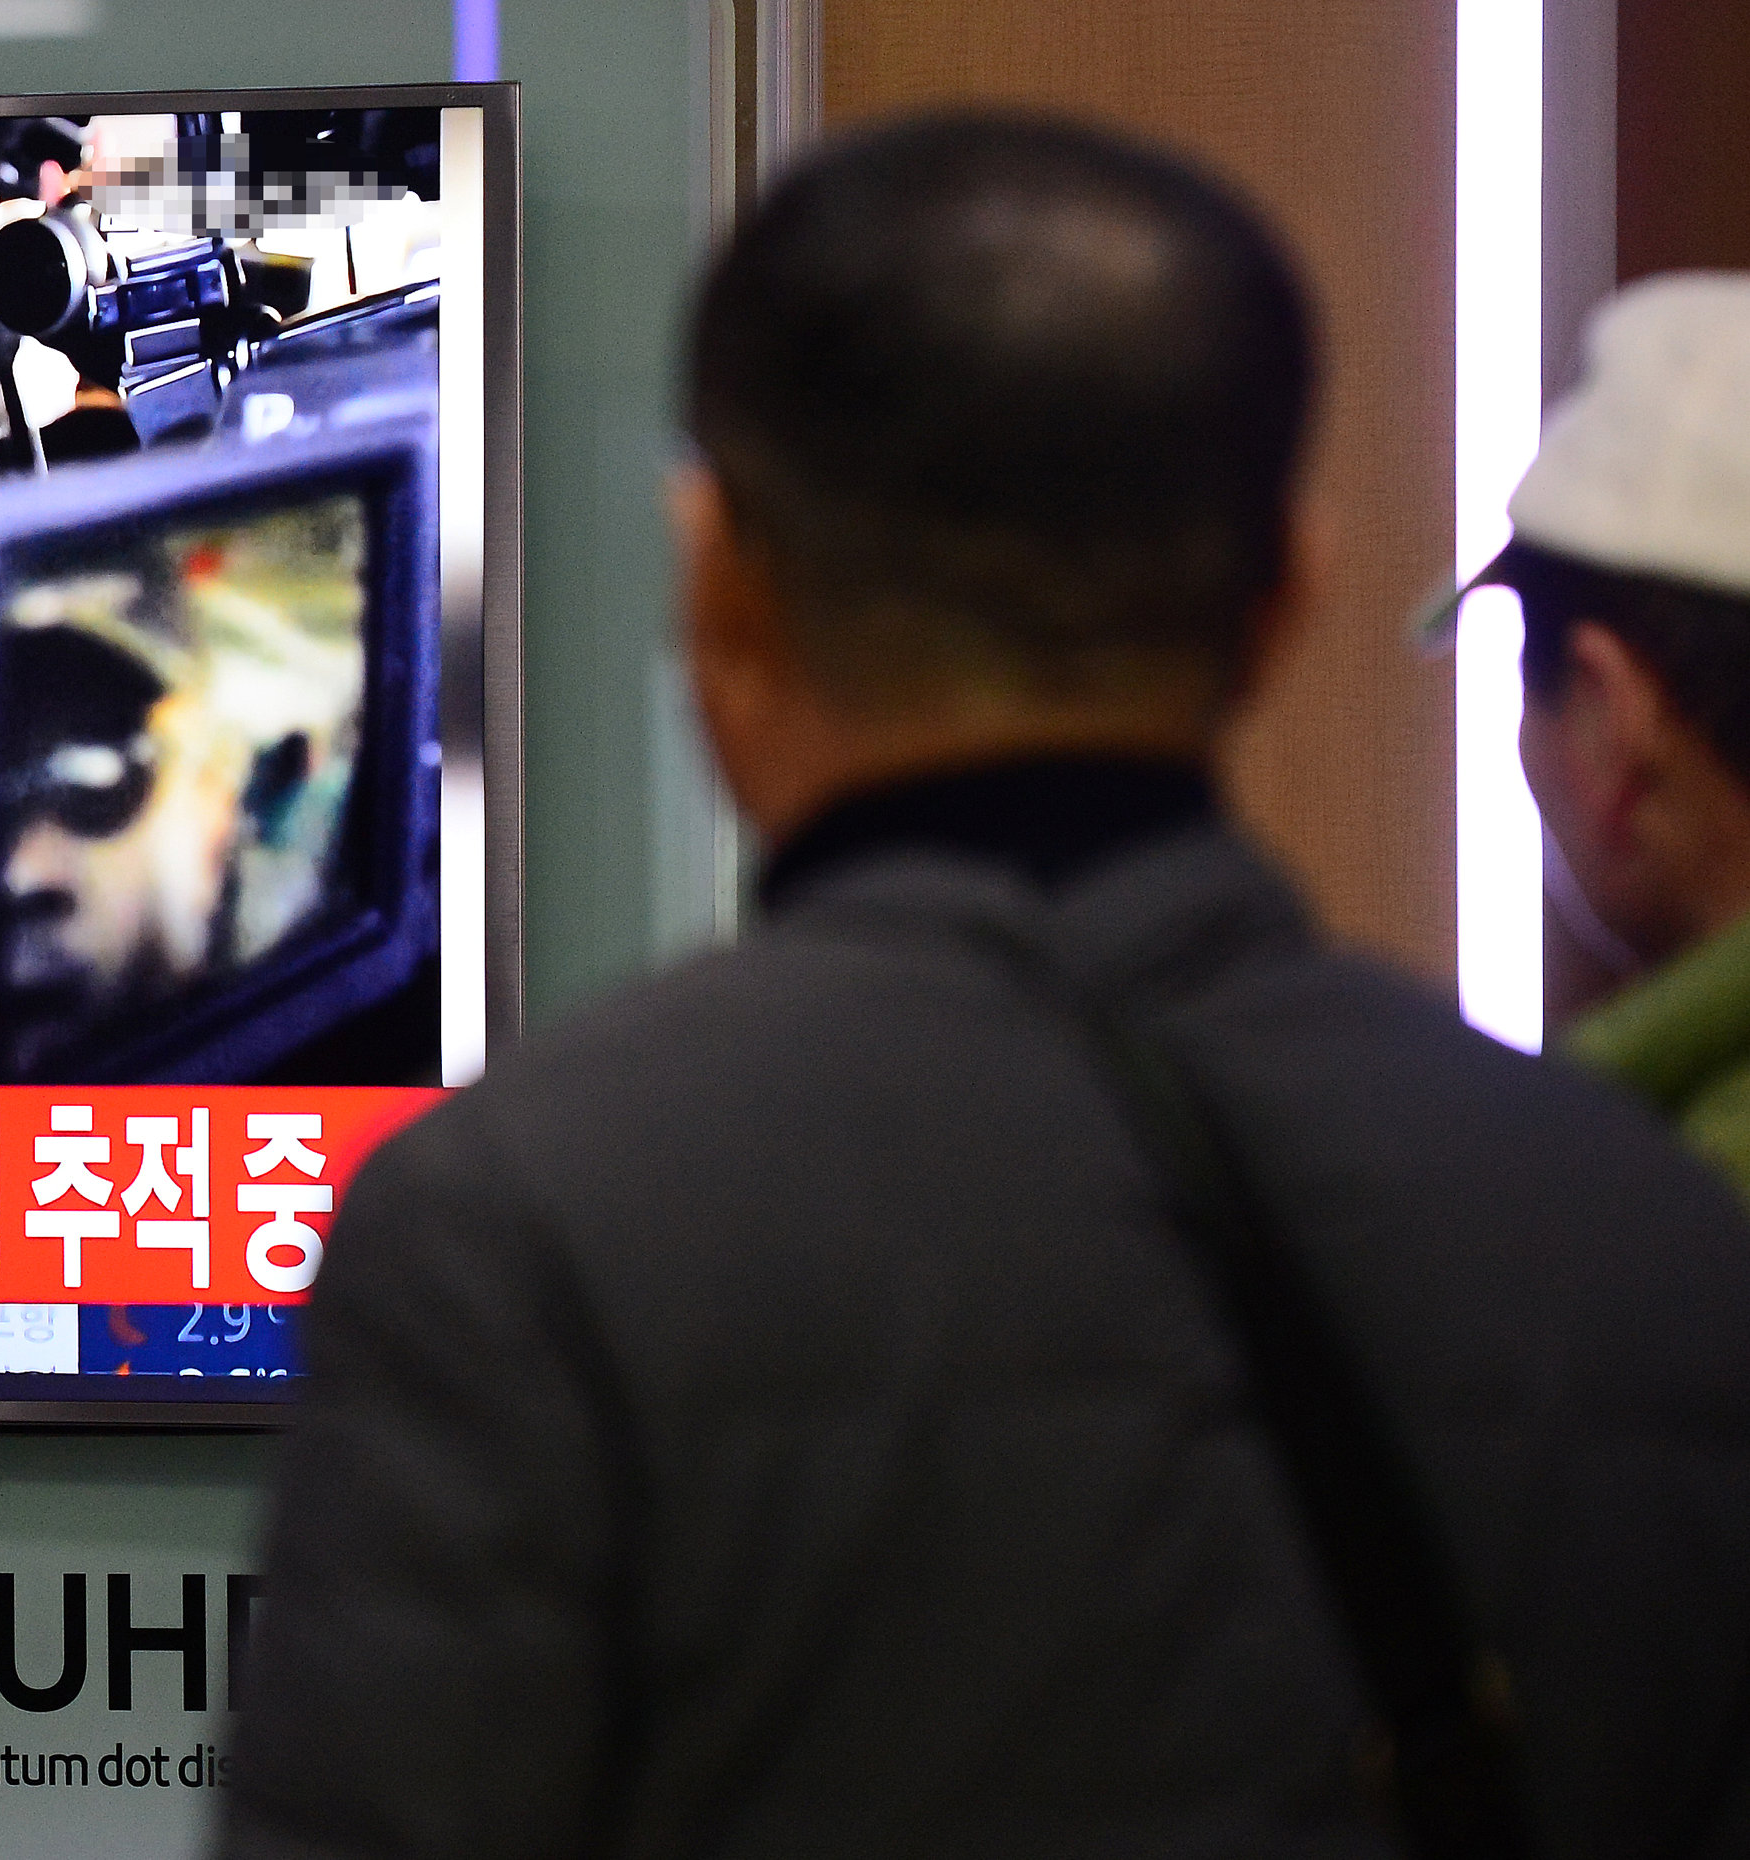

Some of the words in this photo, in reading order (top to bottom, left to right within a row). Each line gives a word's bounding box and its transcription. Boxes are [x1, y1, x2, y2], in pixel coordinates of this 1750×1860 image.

[24, 1105, 210, 1289] 추적
[237, 1113, 333, 1293] 중
[97, 1742, 171, 1788] dot
